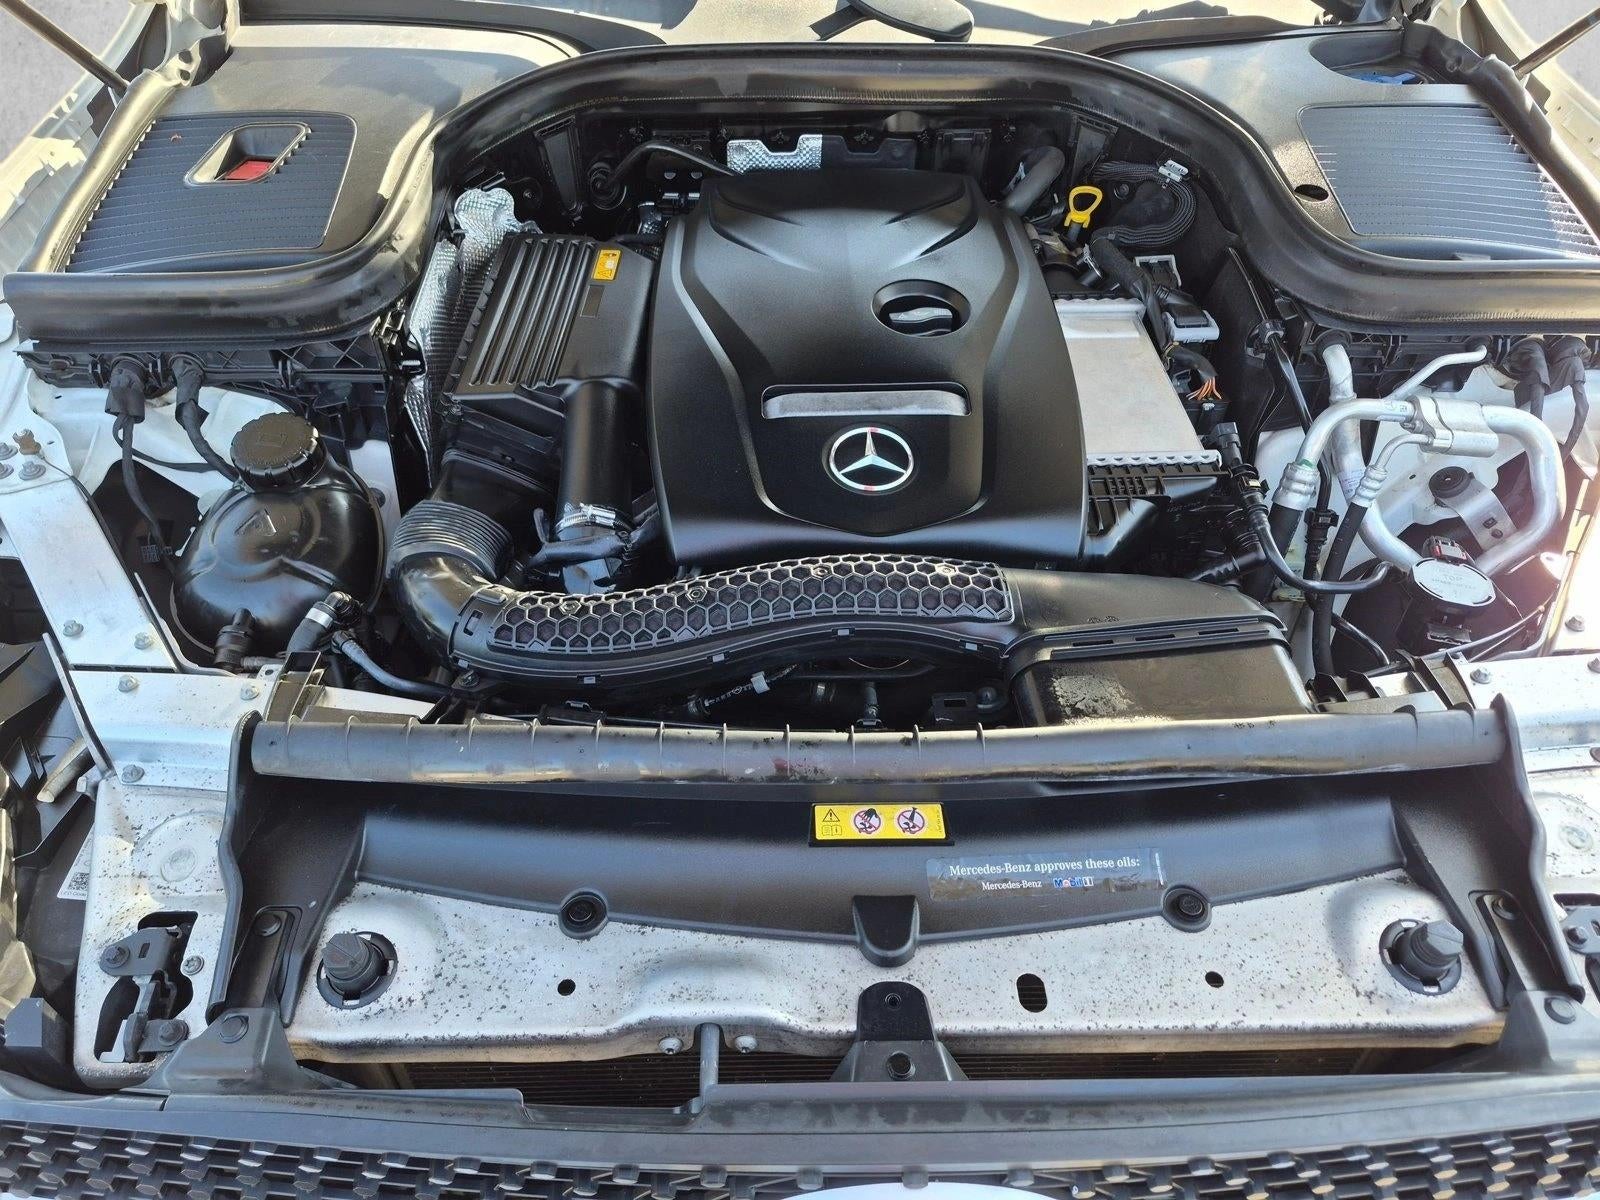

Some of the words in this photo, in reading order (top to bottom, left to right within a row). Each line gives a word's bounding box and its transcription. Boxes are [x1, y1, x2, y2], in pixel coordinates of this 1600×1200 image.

[949, 863, 1032, 876] Mercedes-Benz
[1034, 861, 1083, 873] approves
[1085, 859, 1115, 869] these
[1117, 857, 1140, 867] oils:
[981, 880, 1042, 890] Mercedes-Benz
